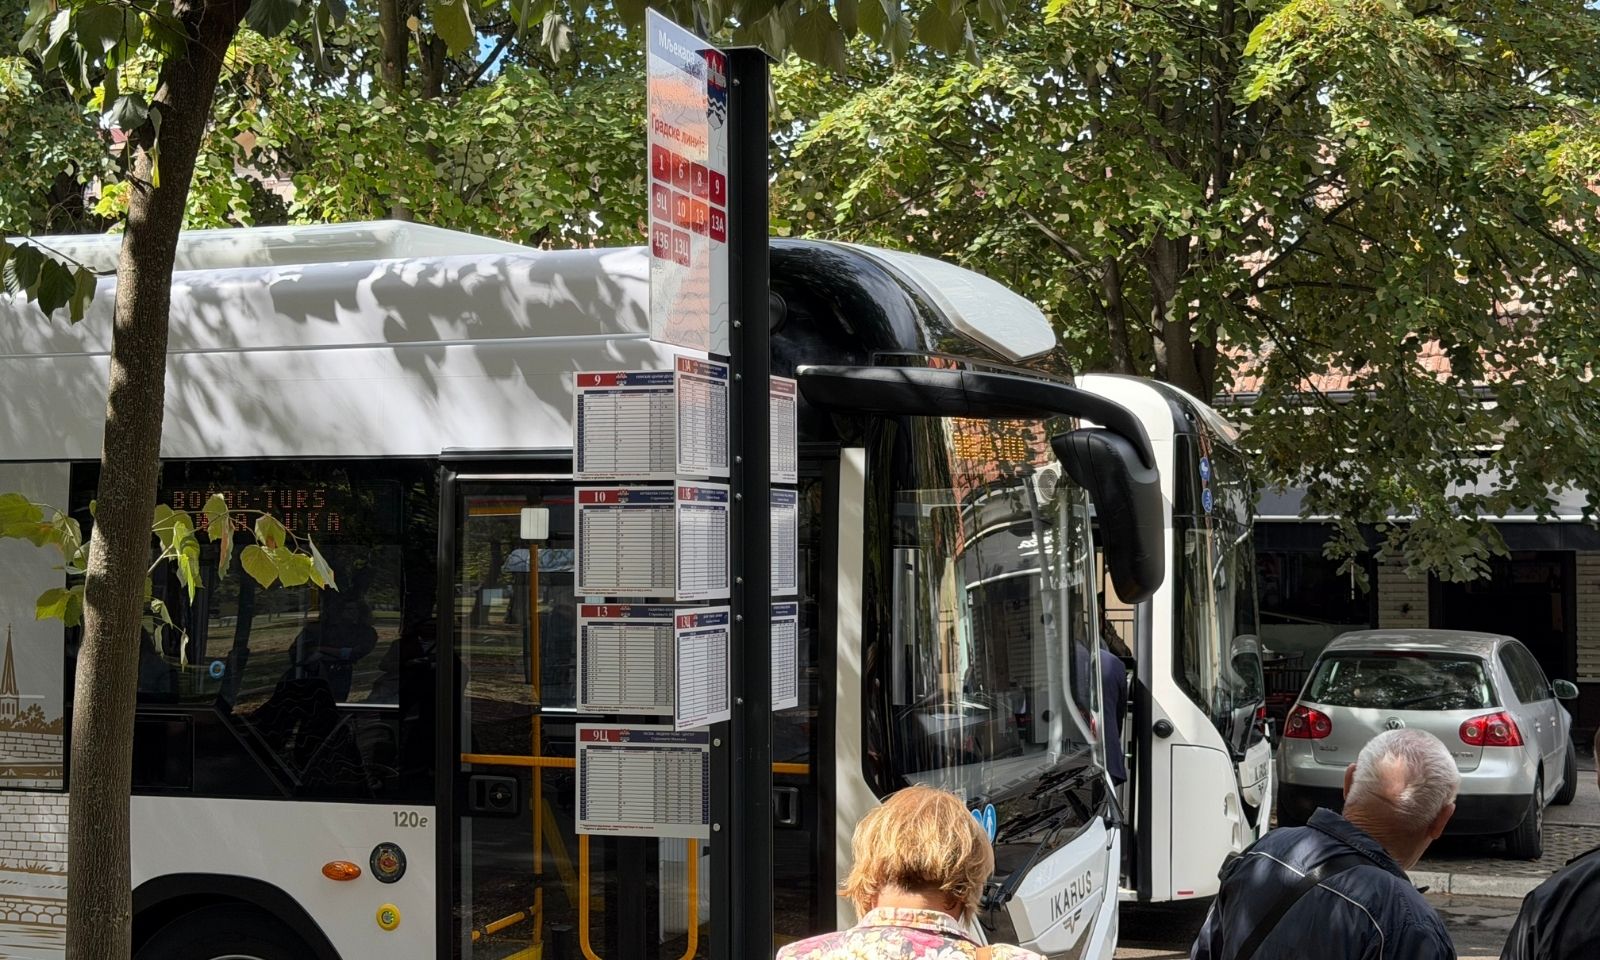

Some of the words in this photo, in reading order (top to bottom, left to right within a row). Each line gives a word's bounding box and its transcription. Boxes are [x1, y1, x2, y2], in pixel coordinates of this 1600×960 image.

[658, 29, 695, 64] Мљекара
[651, 113, 680, 141] Градске
[659, 154, 664, 171] 1
[678, 165, 684, 179] 6
[714, 179, 720, 195] 9
[656, 191, 667, 214] 9Ц
[677, 201, 686, 217] 10
[695, 208, 704, 225] 13
[655, 230, 669, 250] 13Б
[674, 237, 689, 259] 13Ц
[594, 374, 601, 386] 9
[173, 488, 326, 509] BOAC-TURS
[594, 491, 606, 503] 10
[284, 512, 341, 532] UKA
[596, 606, 608, 617] 13
[593, 730, 609, 743] 9Ц
[393, 811, 428, 828] 120e
[1050, 870, 1092, 922] IKARUS
